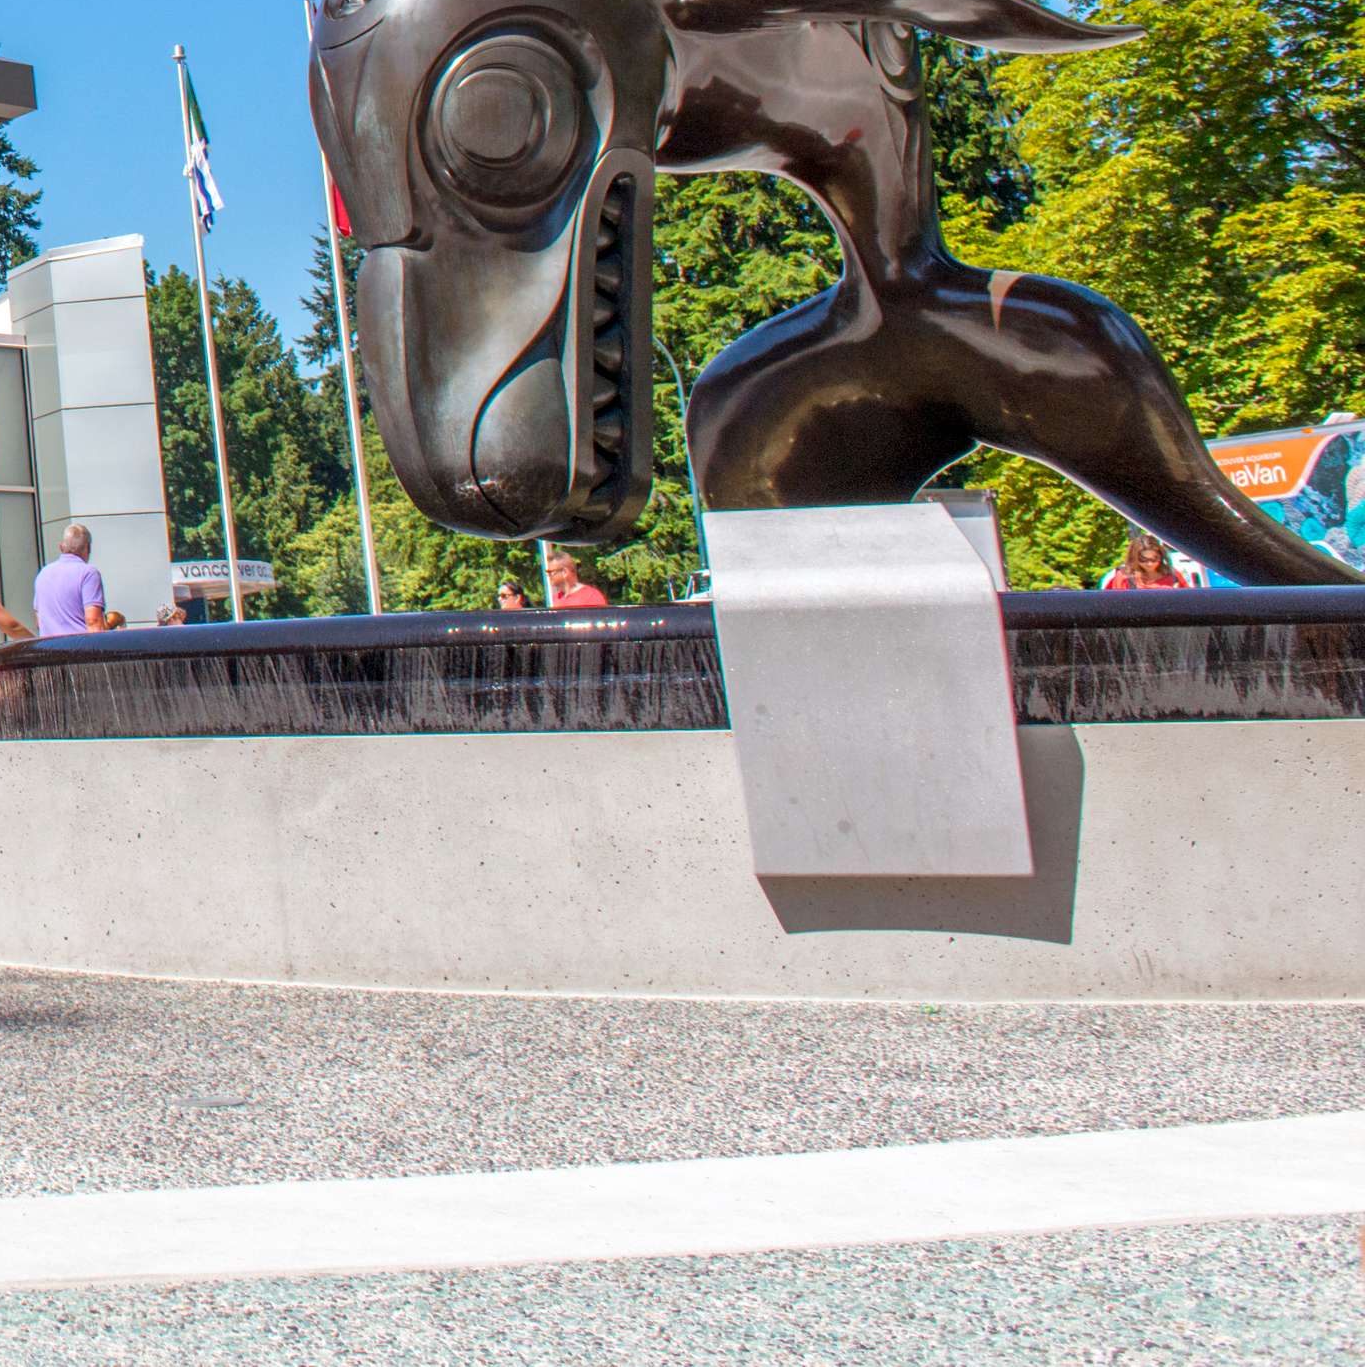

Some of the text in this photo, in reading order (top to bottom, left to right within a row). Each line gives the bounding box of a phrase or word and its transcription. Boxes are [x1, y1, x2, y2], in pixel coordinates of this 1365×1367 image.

[1218, 456, 1245, 466] COUVER
[1230, 463, 1287, 487] aVan
[180, 564, 256, 578] vancover
